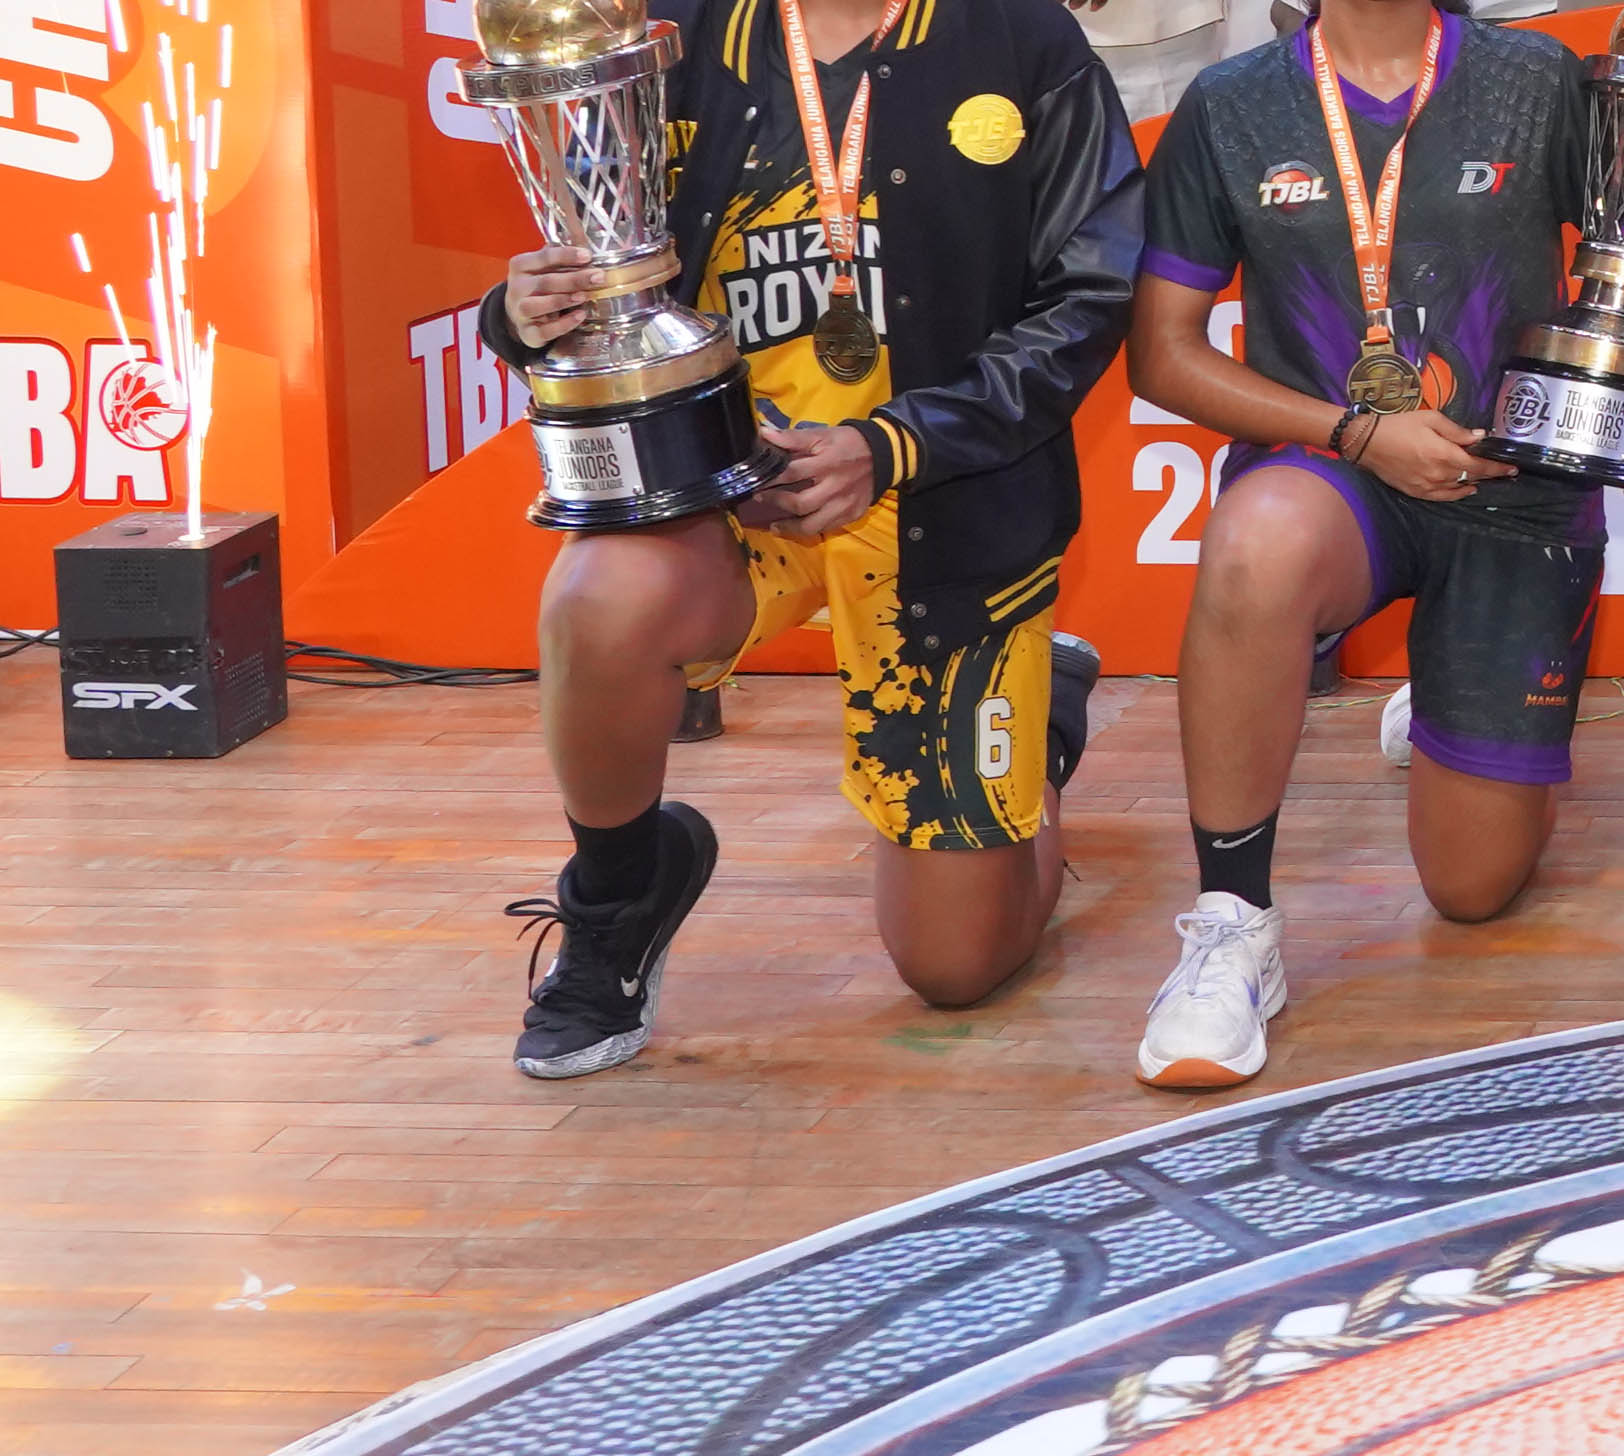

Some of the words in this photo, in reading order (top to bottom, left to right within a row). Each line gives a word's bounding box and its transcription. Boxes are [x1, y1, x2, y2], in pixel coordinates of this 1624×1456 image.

[800, 74, 822, 123] JUNIORS
[1320, 70, 1346, 131] BASKETBALL
[810, 125, 836, 195] TELANGANA
[843, 124, 863, 194] TELANGANA
[1334, 130, 1355, 178] JUNIORS
[1457, 161, 1516, 194] DT
[1259, 177, 1330, 207] TJBL
[1348, 179, 1371, 247] TELANGANA
[1376, 178, 1396, 246] TELANGANA
[410, 306, 524, 466] TB
[1351, 376, 1421, 402] TJBL
[1504, 395, 1551, 421] TJBL
[0, 341, 170, 502] BA
[1557, 407, 1624, 440] JUNIORS
[557, 453, 621, 480] JUNIORS
[72, 681, 199, 711] SFX
[976, 696, 1012, 779] 6
